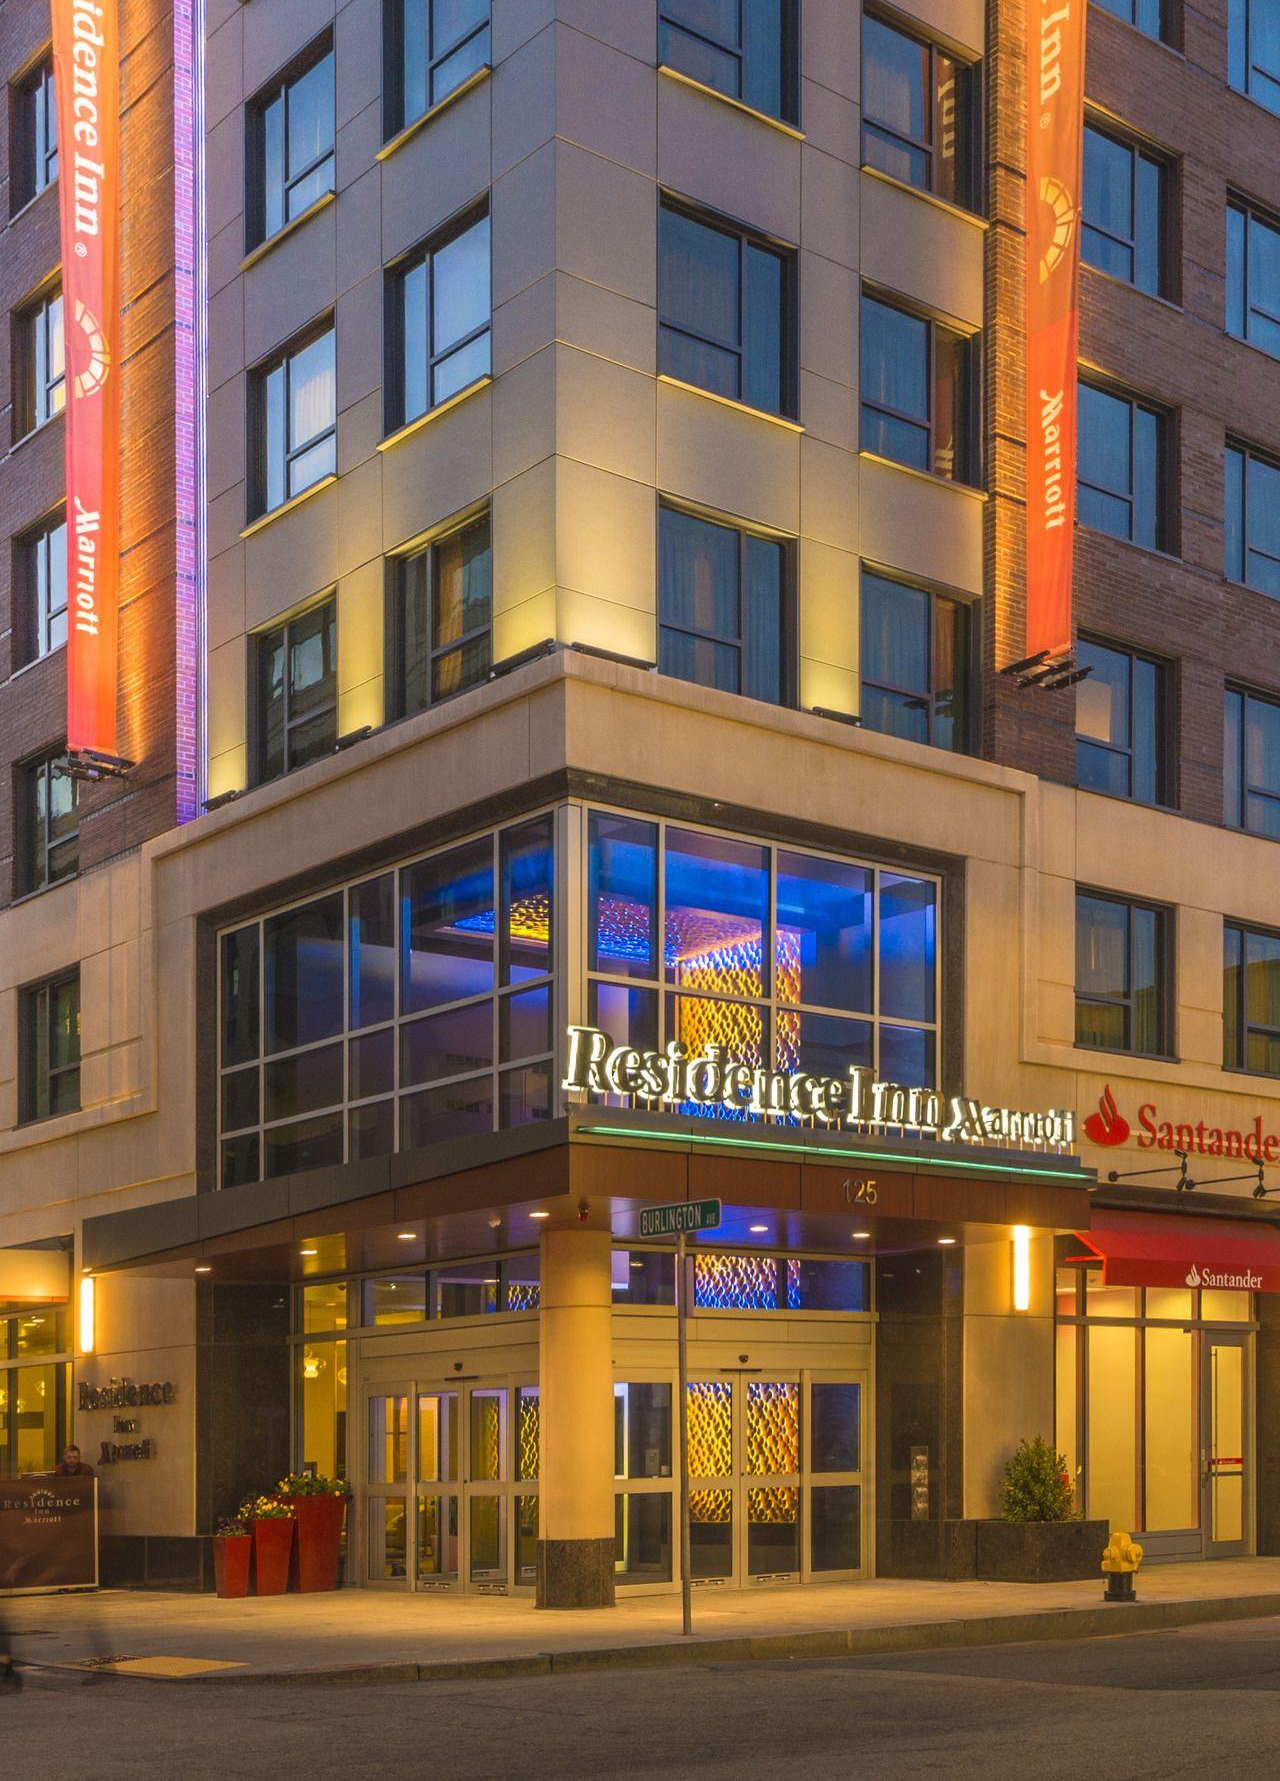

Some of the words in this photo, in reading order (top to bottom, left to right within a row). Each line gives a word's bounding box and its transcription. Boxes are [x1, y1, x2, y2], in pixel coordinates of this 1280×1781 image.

[1040, 8, 1071, 106] Inn
[74, 151, 105, 236] Inn
[1040, 388, 1065, 531] Marriott
[73, 496, 101, 636] Marriott
[562, 1025, 844, 1121] Residence
[846, 1065, 946, 1130] Inn
[642, 1205, 701, 1234] BURLINGTON
[706, 1213, 716, 1225] AVE
[842, 1179, 877, 1204] 125
[1201, 1268, 1263, 1288] Santander
[3, 1498, 80, 1509] Residence
[22, 1515, 61, 1525] Marriott
